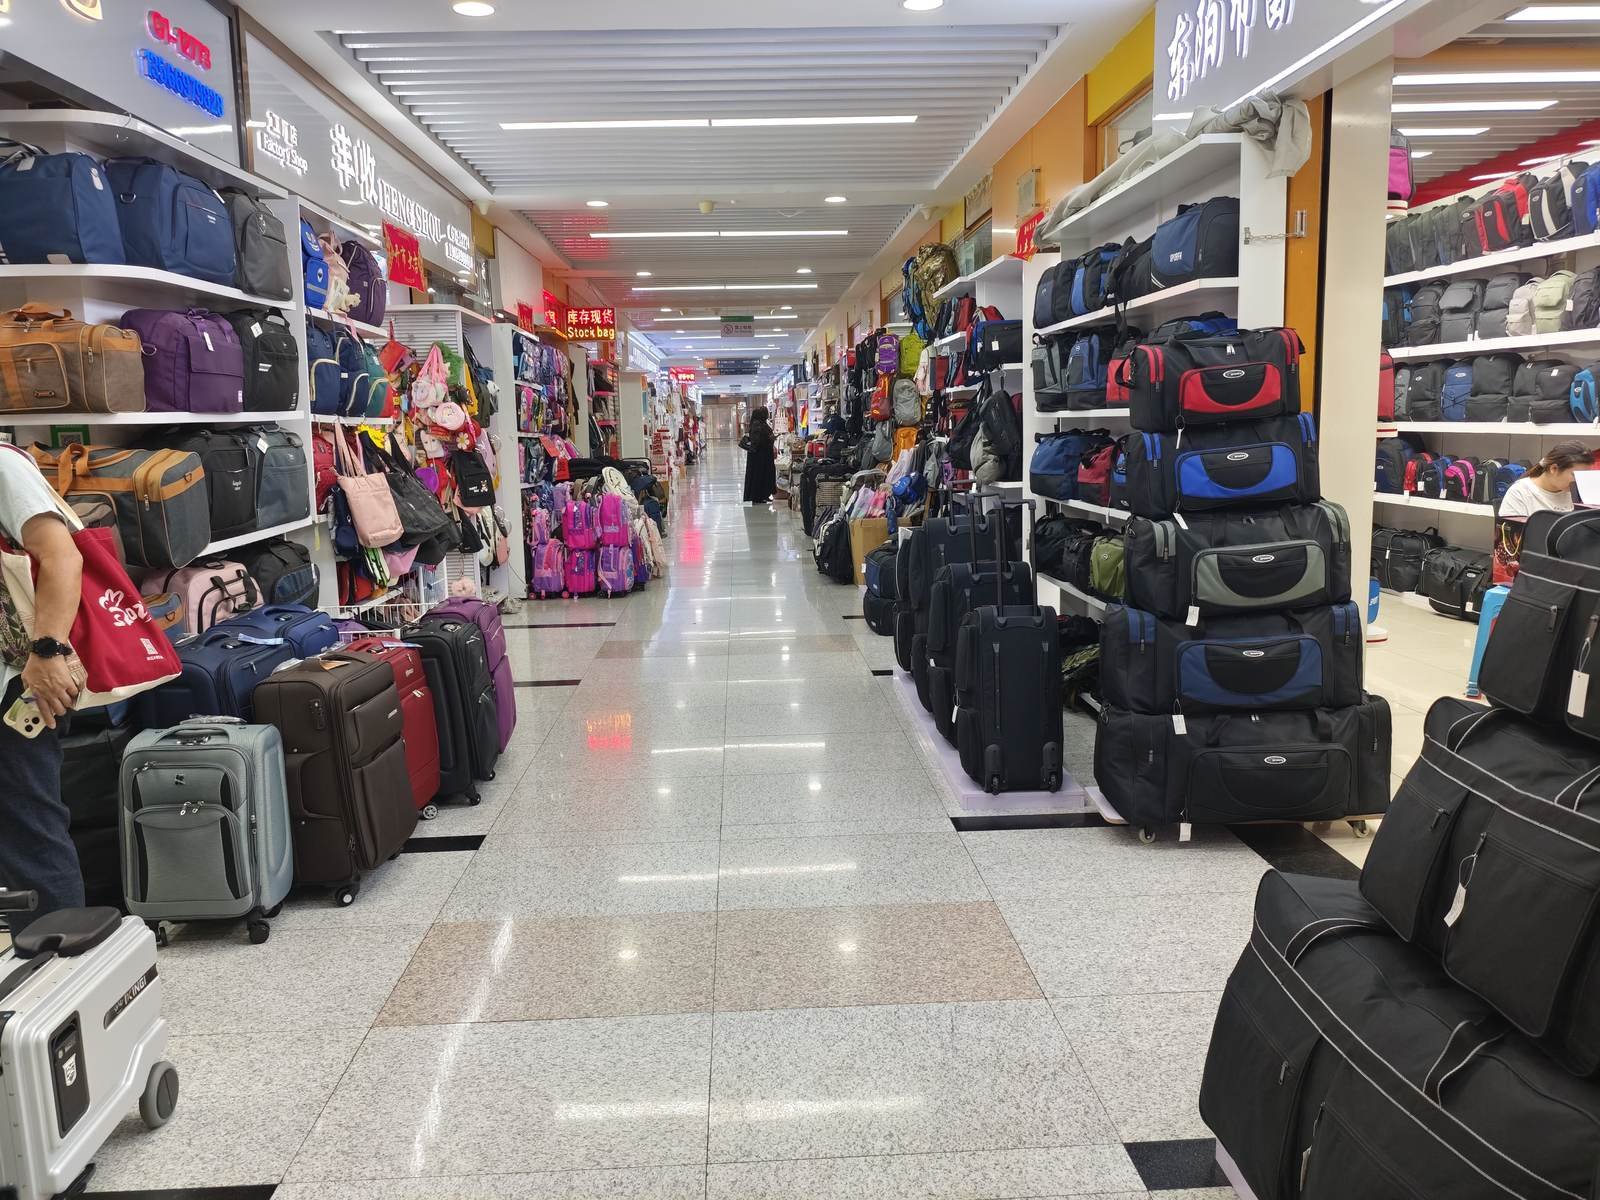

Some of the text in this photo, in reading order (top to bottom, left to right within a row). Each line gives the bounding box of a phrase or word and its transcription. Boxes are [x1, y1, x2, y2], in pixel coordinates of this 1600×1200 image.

[258, 132, 309, 177] Factory Shop
[567, 309, 614, 325] 库存现货
[567, 326, 615, 340] Stock bag
